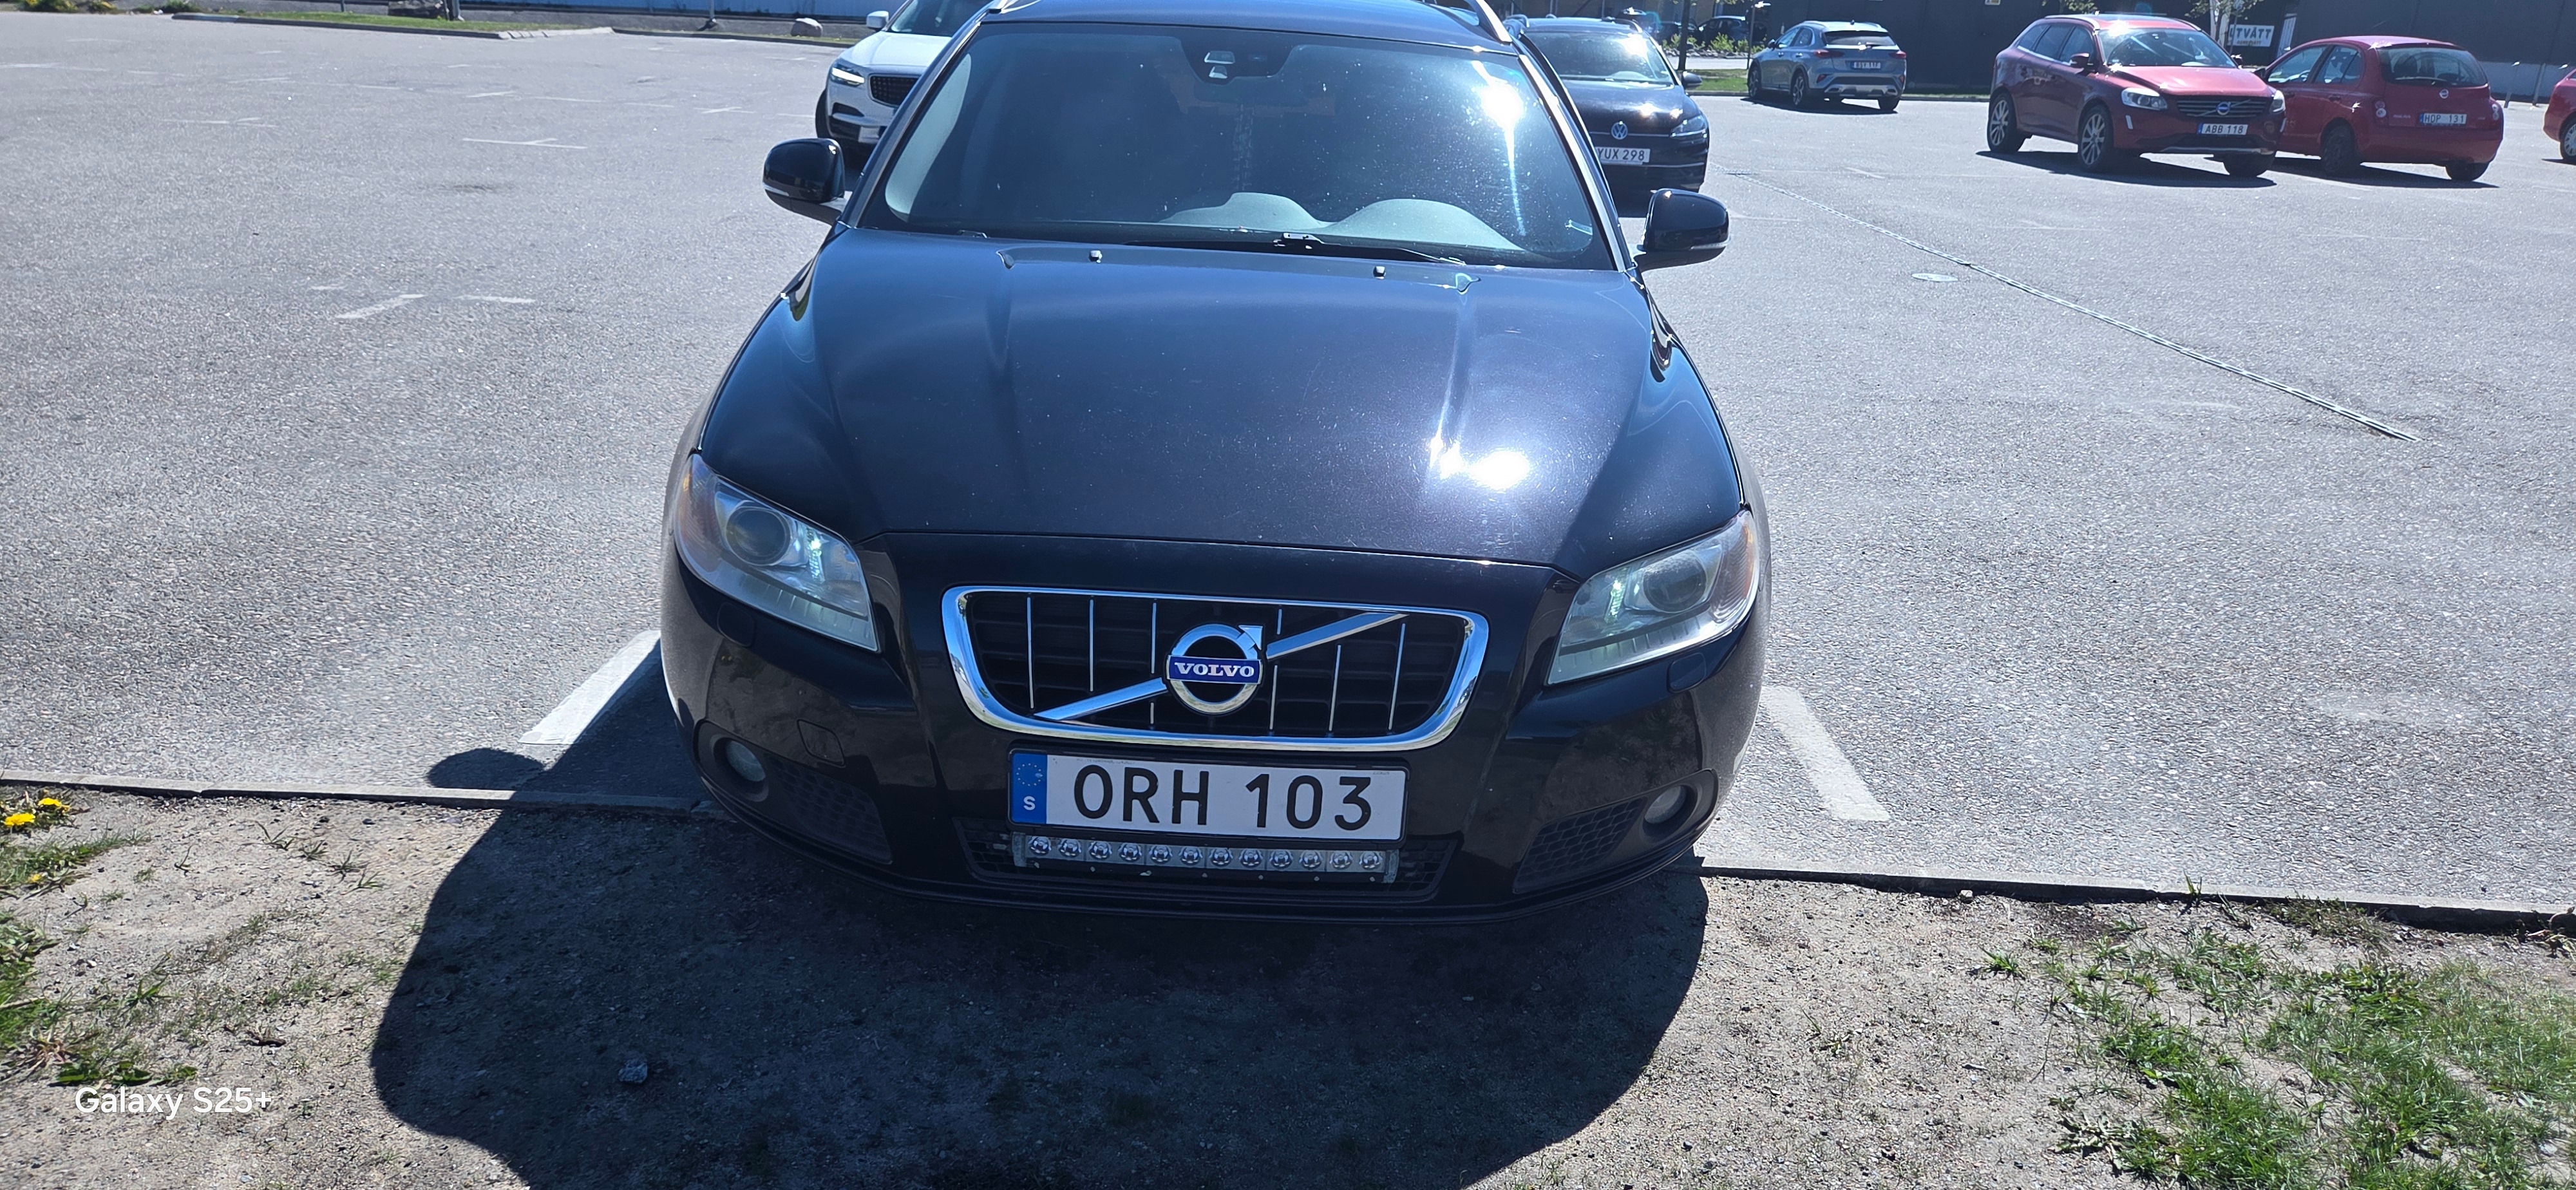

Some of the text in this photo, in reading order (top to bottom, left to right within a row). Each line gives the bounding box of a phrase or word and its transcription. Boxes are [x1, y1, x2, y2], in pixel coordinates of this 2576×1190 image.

[2449, 115, 2464, 123] 131
[2205, 125, 2244, 134] ABB 118
[1597, 148, 1645, 161] YUX 298
[1174, 661, 1255, 677] VOLVO
[1023, 795, 1036, 811] S
[1074, 764, 1372, 831] ORH 103
